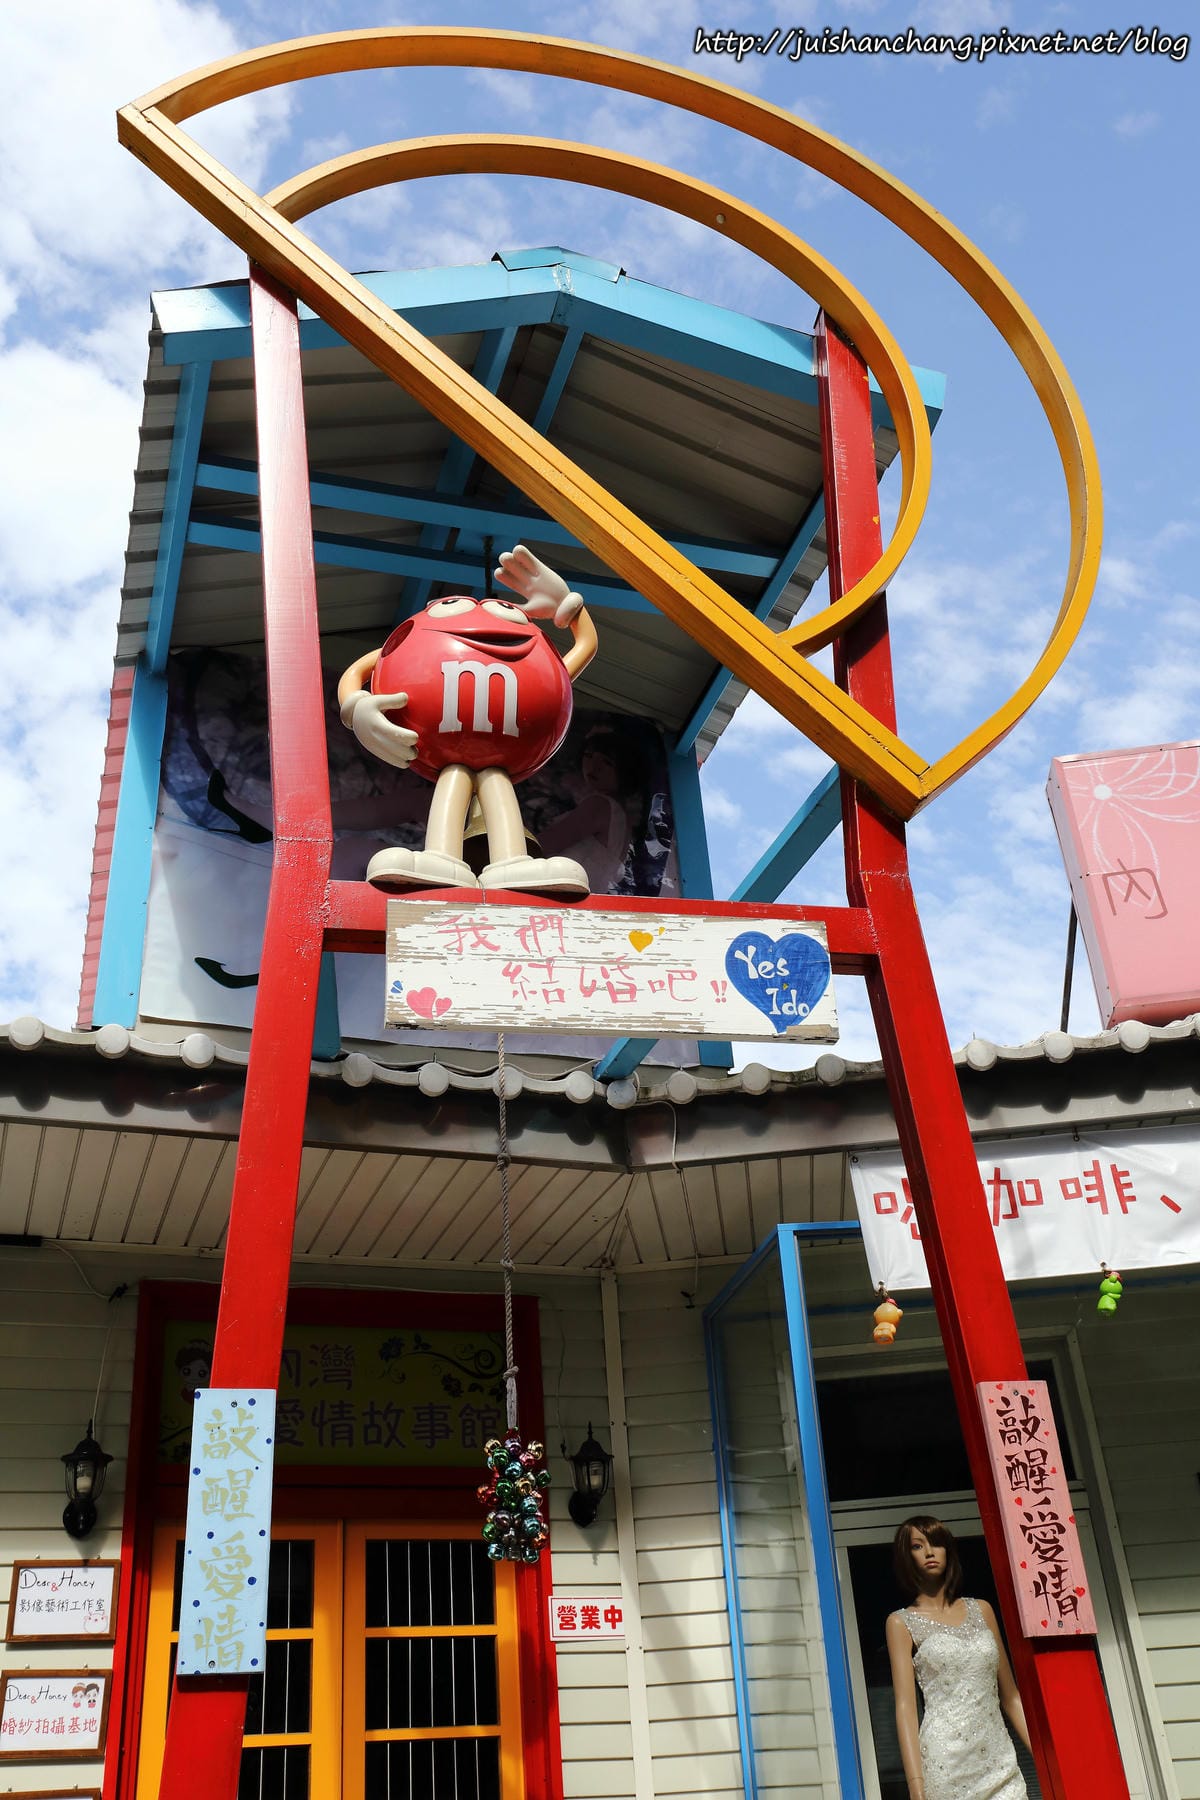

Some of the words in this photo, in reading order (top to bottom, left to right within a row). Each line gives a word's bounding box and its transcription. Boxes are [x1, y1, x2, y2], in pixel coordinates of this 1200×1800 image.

[438, 660, 519, 737] m
[437, 914, 566, 954] 我們
[734, 945, 790, 979] Yes
[996, 1395, 1079, 1621] 敲醒愛情
[193, 1408, 263, 1672] 敲醒愛情
[19, 1598, 105, 1613] 影像藝術工作室
[557, 1604, 623, 1630] 營業中
[2, 1716, 98, 1736] 婚紗拍攝基地
